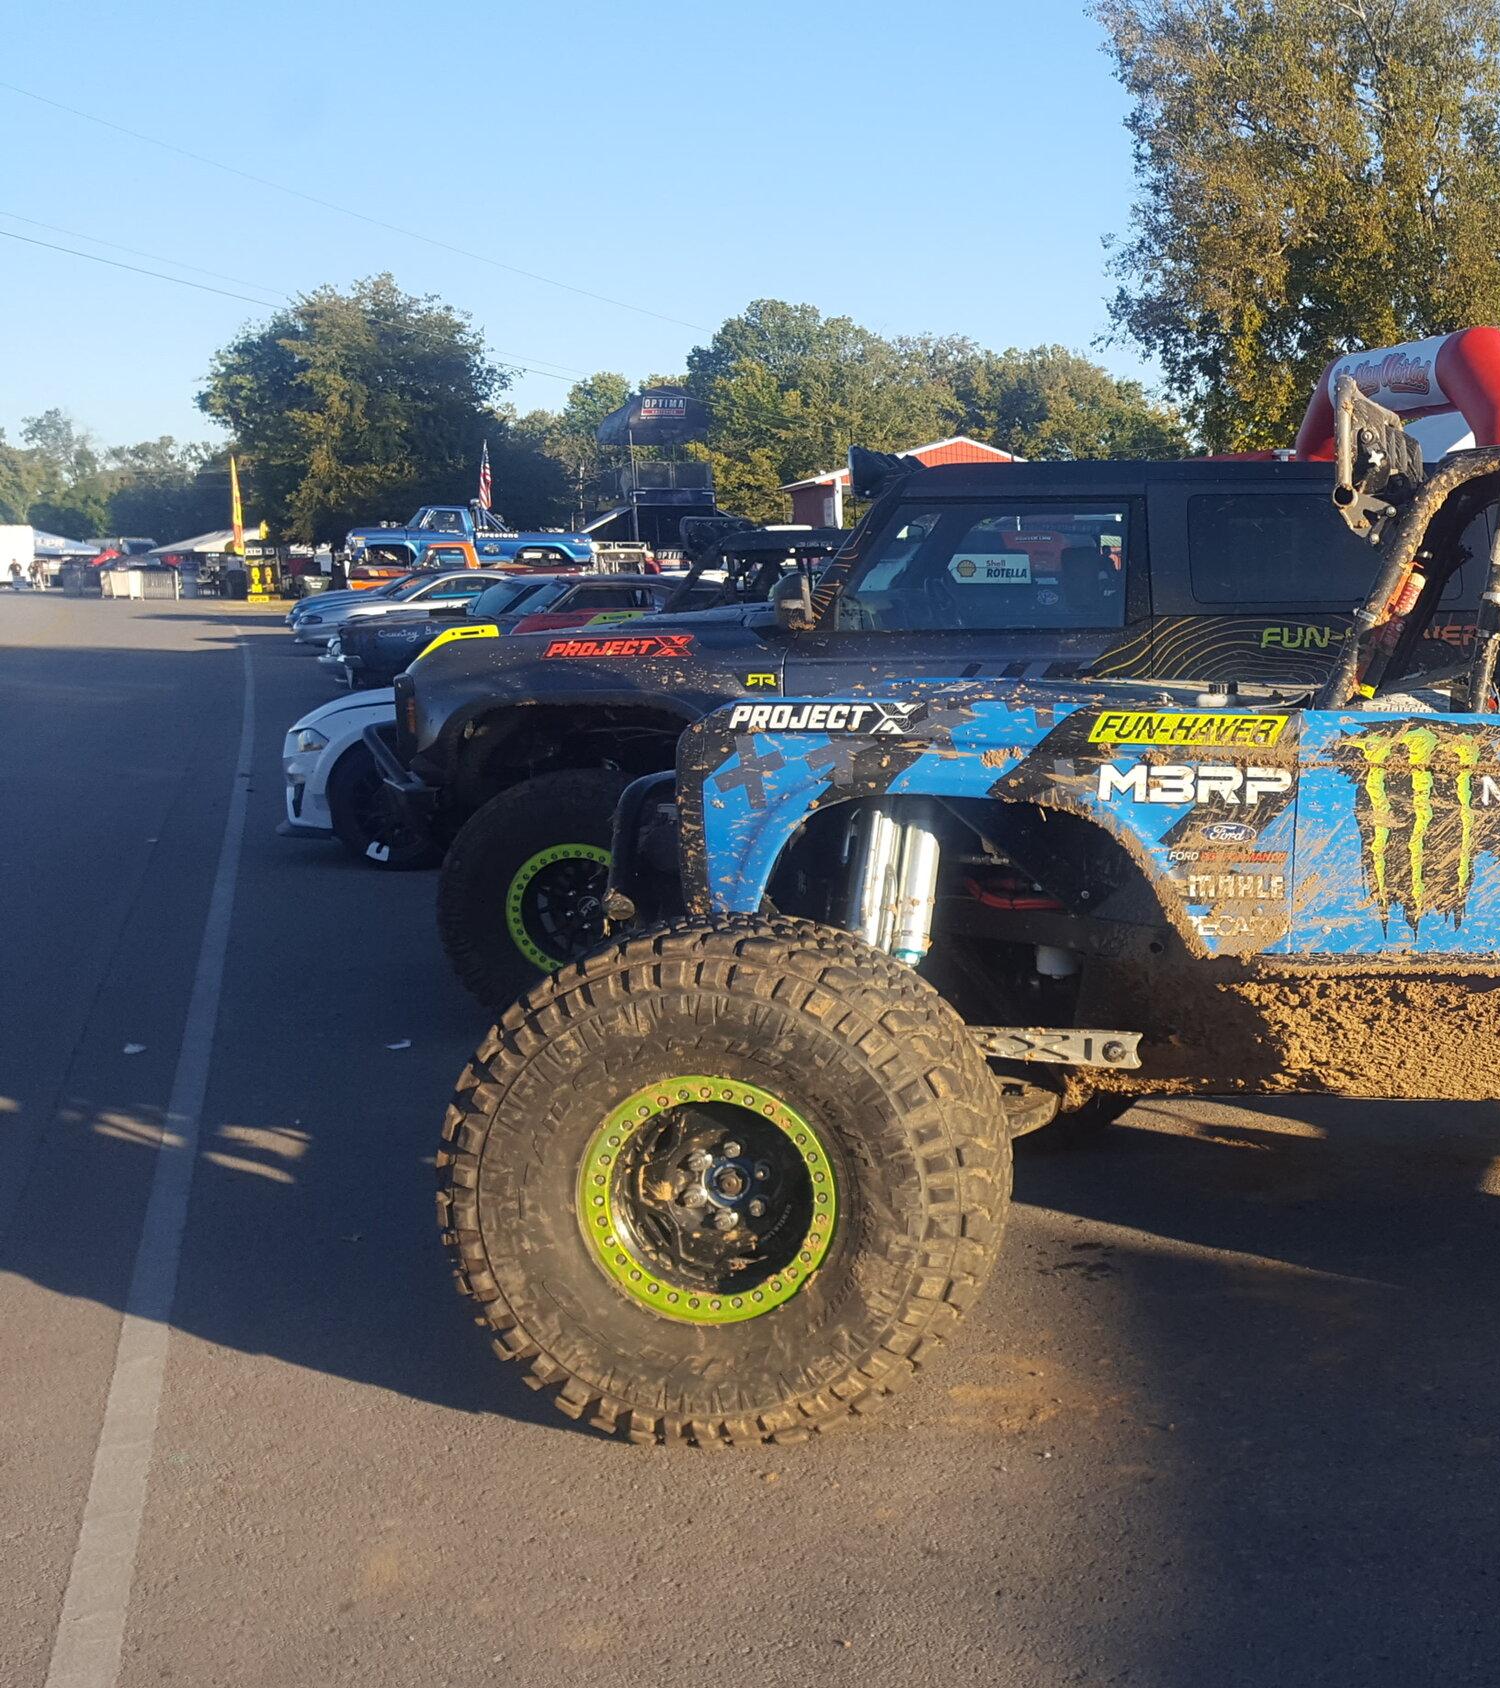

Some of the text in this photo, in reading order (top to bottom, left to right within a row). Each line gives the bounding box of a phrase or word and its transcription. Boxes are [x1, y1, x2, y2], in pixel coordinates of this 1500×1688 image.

[644, 398, 685, 409] OPTIMA
[986, 568, 1028, 578] ROTELLA
[547, 640, 657, 657] PROJECT
[729, 704, 873, 730] PROJECT
[1096, 715, 1280, 744] FUN-HAVER
[1098, 763, 1292, 806] MBRP
[1209, 823, 1247, 841] Ford
[1169, 852, 1199, 861] FORD
